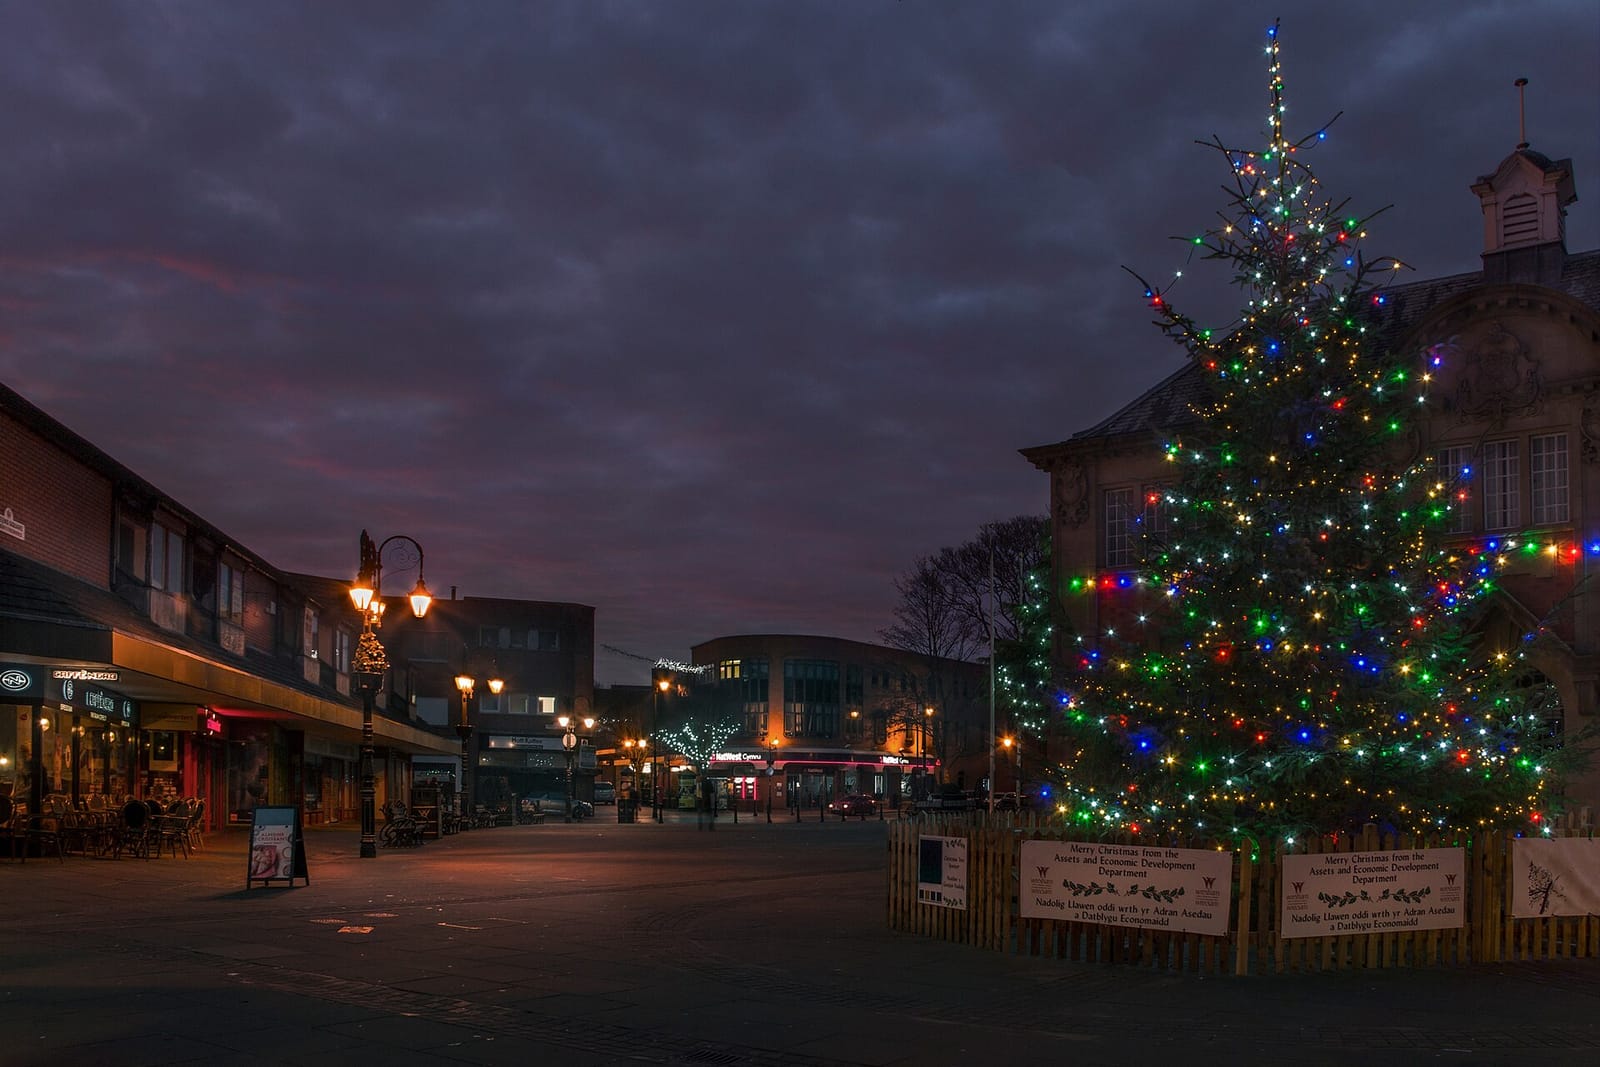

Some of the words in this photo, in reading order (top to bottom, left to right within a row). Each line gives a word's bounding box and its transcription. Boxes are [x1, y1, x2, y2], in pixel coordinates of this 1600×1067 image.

[716, 752, 742, 761] NatWest
[742, 753, 762, 761] Cymru
[1071, 844, 1095, 855] Merry
[1098, 845, 1138, 856] Christmas
[1142, 848, 1162, 857] from
[1165, 849, 1179, 858] the
[1054, 853, 1080, 864] Assets
[1083, 856, 1097, 864] and
[1100, 856, 1138, 867] Economic
[1141, 858, 1195, 871] Development
[1325, 856, 1348, 865] Merry
[1351, 854, 1389, 864] Christmas
[1392, 853, 1409, 862] from
[1412, 852, 1424, 860] the
[1098, 866, 1147, 878] Department
[1309, 867, 1334, 876] Assets
[1337, 865, 1351, 874] and
[1353, 865, 1389, 874] Economic
[1391, 863, 1439, 873] Development
[1352, 875, 1397, 885] Department
[1036, 897, 1065, 910] Nadolig
[1068, 900, 1094, 911] Llawen
[1097, 902, 1115, 911] oddi
[1118, 905, 1138, 914] wrth
[1140, 907, 1149, 916] yr
[1153, 907, 1178, 917] Adran
[1181, 909, 1212, 919] Asedau
[1291, 913, 1320, 923] Nadolig
[1323, 912, 1349, 921] Llawen
[1352, 910, 1369, 919] oddi
[1371, 909, 1390, 918] wrth
[1392, 911, 1400, 919] yr
[1404, 907, 1425, 916] Adran
[1428, 906, 1455, 915] Asedau
[1082, 911, 1117, 923] Datblygu
[1120, 914, 1169, 926] Economaidd
[1337, 921, 1371, 931] Datblygu
[1374, 918, 1418, 928] Economaidd
